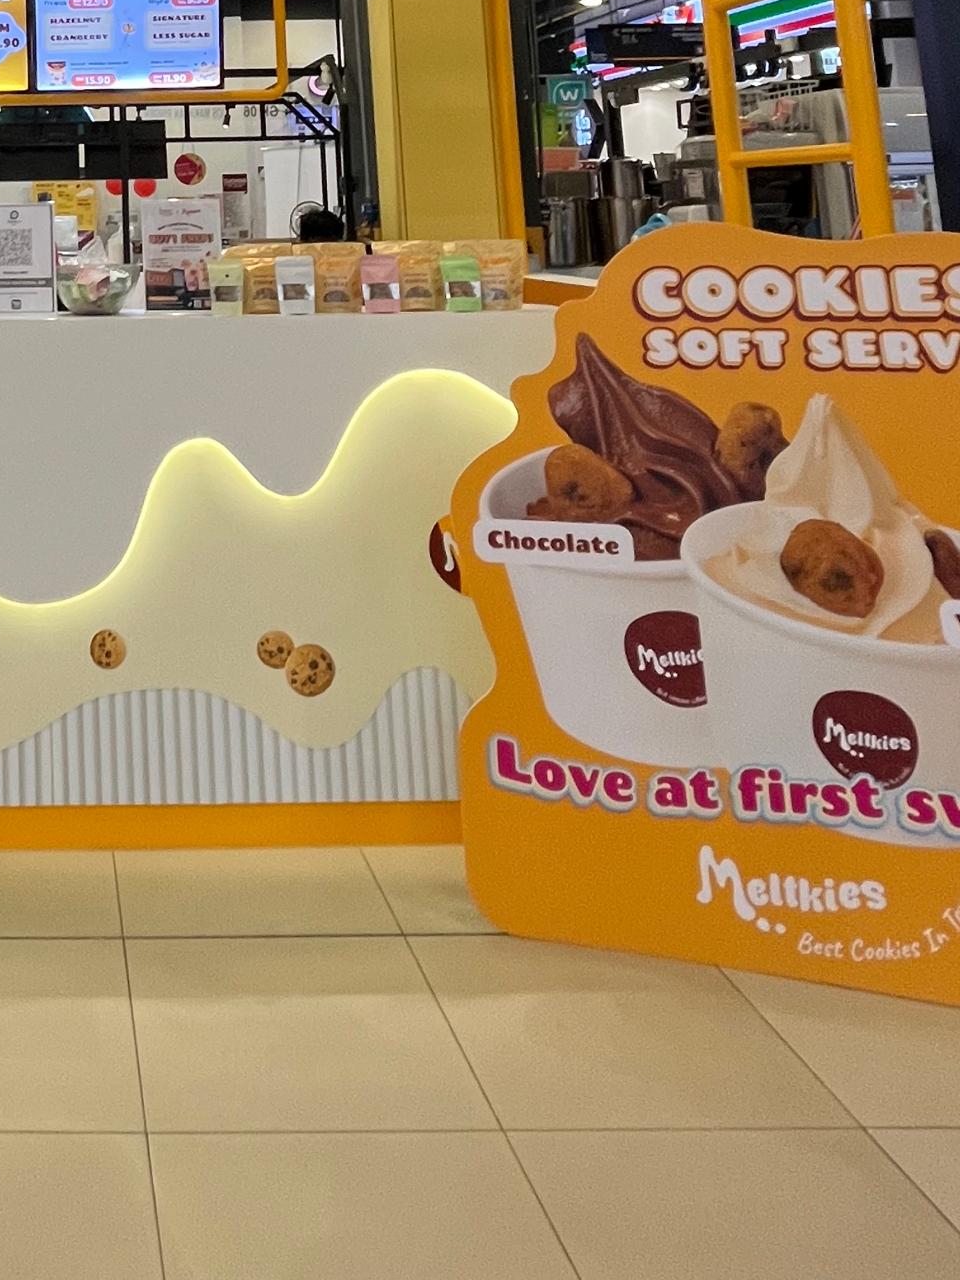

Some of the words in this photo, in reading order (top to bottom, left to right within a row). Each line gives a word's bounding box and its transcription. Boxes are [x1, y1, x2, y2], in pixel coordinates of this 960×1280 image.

[50, 16, 102, 25] HAZELNUT
[152, 14, 207, 22] SIGNATURE
[152, 32, 176, 40] LESS
[179, 31, 211, 39] SUGAR
[642, 327, 789, 370] SOFT
[487, 529, 620, 556] Chocolate
[822, 716, 912, 754] Meltkies
[494, 736, 636, 805] Love
[653, 769, 720, 811] at
[737, 767, 885, 820] first
[695, 844, 888, 922] Meltkies
[797, 931, 844, 958] Best
[850, 937, 922, 963] Cookies
[922, 927, 950, 954] In
